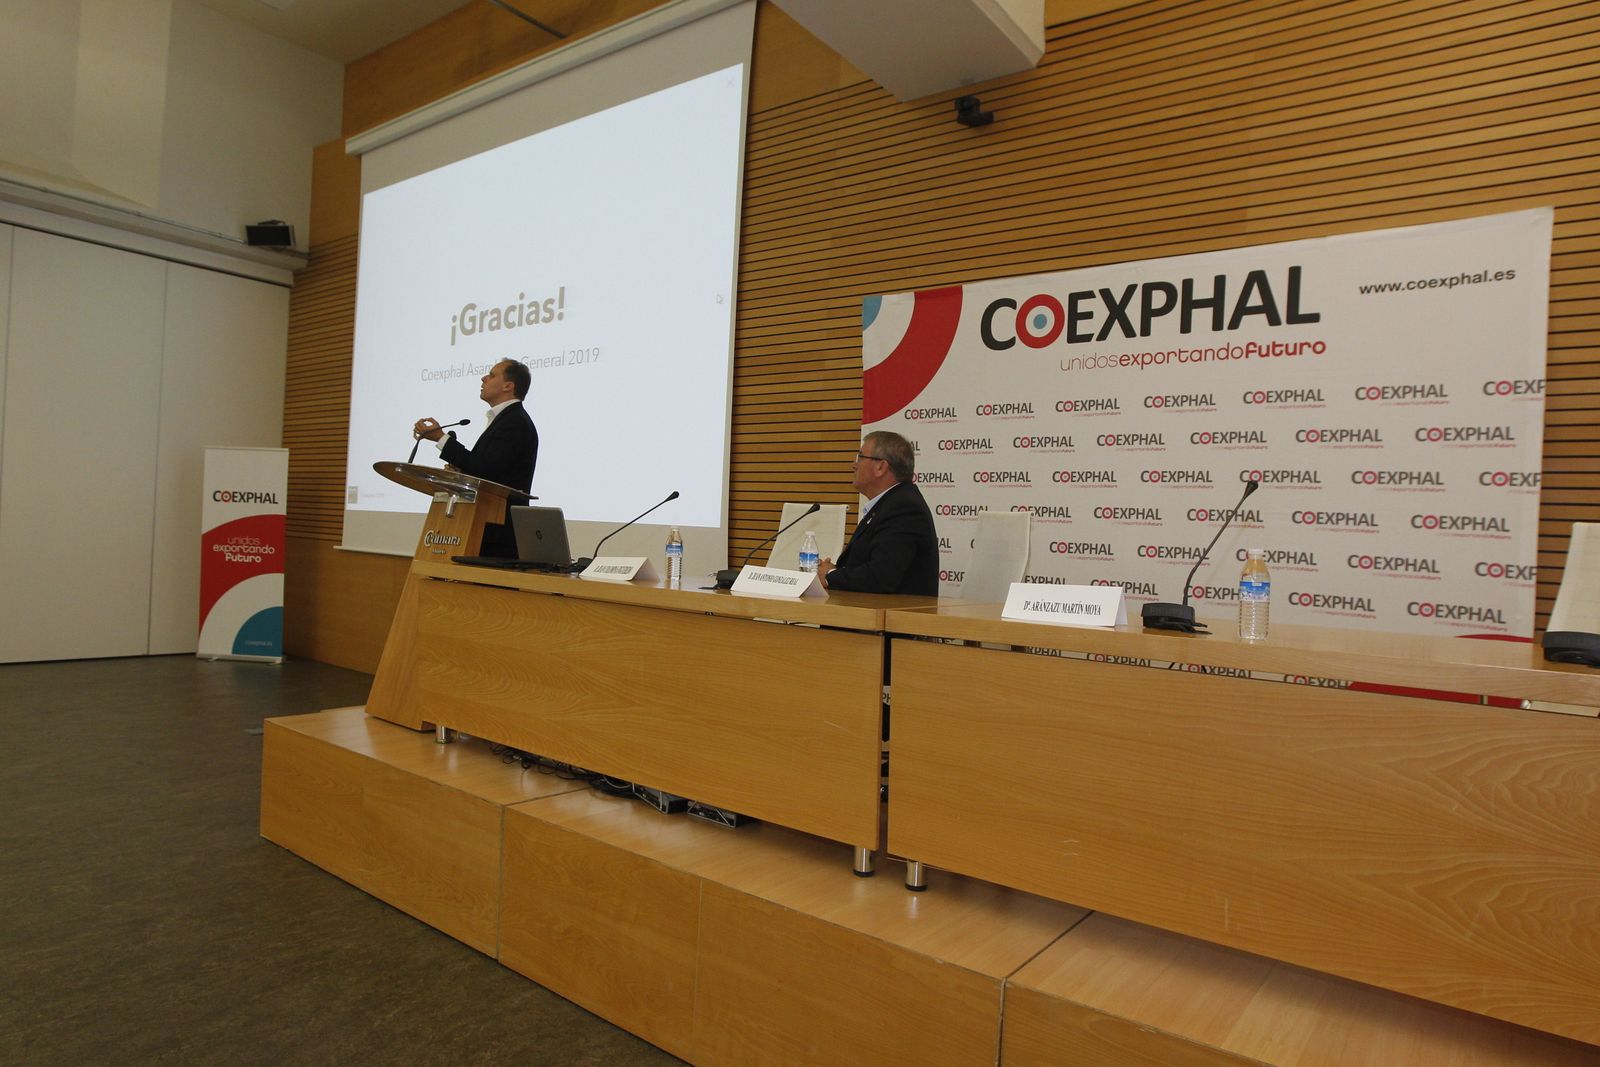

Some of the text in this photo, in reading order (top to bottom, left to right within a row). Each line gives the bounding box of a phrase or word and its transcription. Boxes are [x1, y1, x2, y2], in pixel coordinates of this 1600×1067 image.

[1359, 268, 1516, 295] www.coexphal.es
[980, 265, 1321, 351] COEXPHAL
[450, 286, 566, 346] ¡Gracias!
[421, 362, 465, 383] Coexphal
[568, 347, 600, 365] 2019
[1243, 389, 1325, 404] COEXPHAL
[1355, 384, 1448, 400] COEXPHAL
[1055, 398, 1120, 412] COEXPHAL
[1143, 393, 1216, 408] COEXPHAL
[904, 407, 957, 420] COEXPHAL
[975, 402, 1035, 416] COEXPHAL
[1097, 433, 1165, 446] COEXPHAL
[1190, 430, 1267, 445] COEXPHAL
[1295, 429, 1383, 443] COEXPHAL
[1415, 426, 1515, 442] COEXPHAL
[938, 438, 993, 451] COEXPHAL
[1013, 436, 1075, 449] COEXPHAL
[973, 471, 1031, 483] COEXPHAL
[1052, 470, 1117, 483] COEXPHAL
[1140, 470, 1213, 483] COEXPHAL
[1239, 469, 1321, 483] COEXPHAL
[1351, 470, 1444, 485] COEXPHAL
[213, 490, 279, 504] COEXPHAL
[1093, 507, 1162, 520] COEXPHAL
[1187, 508, 1263, 522] COEXPHAL
[1292, 510, 1378, 527] COEXPHAL
[1411, 514, 1510, 532] COEXPHAL
[212, 543, 275, 554] exportando
[1049, 541, 1114, 556] COEXPHAL
[225, 552, 262, 563] futuro
[1347, 554, 1440, 573] COEXPHAL
[1288, 592, 1376, 612] COEXPHAL
[1406, 601, 1506, 624] COEXPHAL
